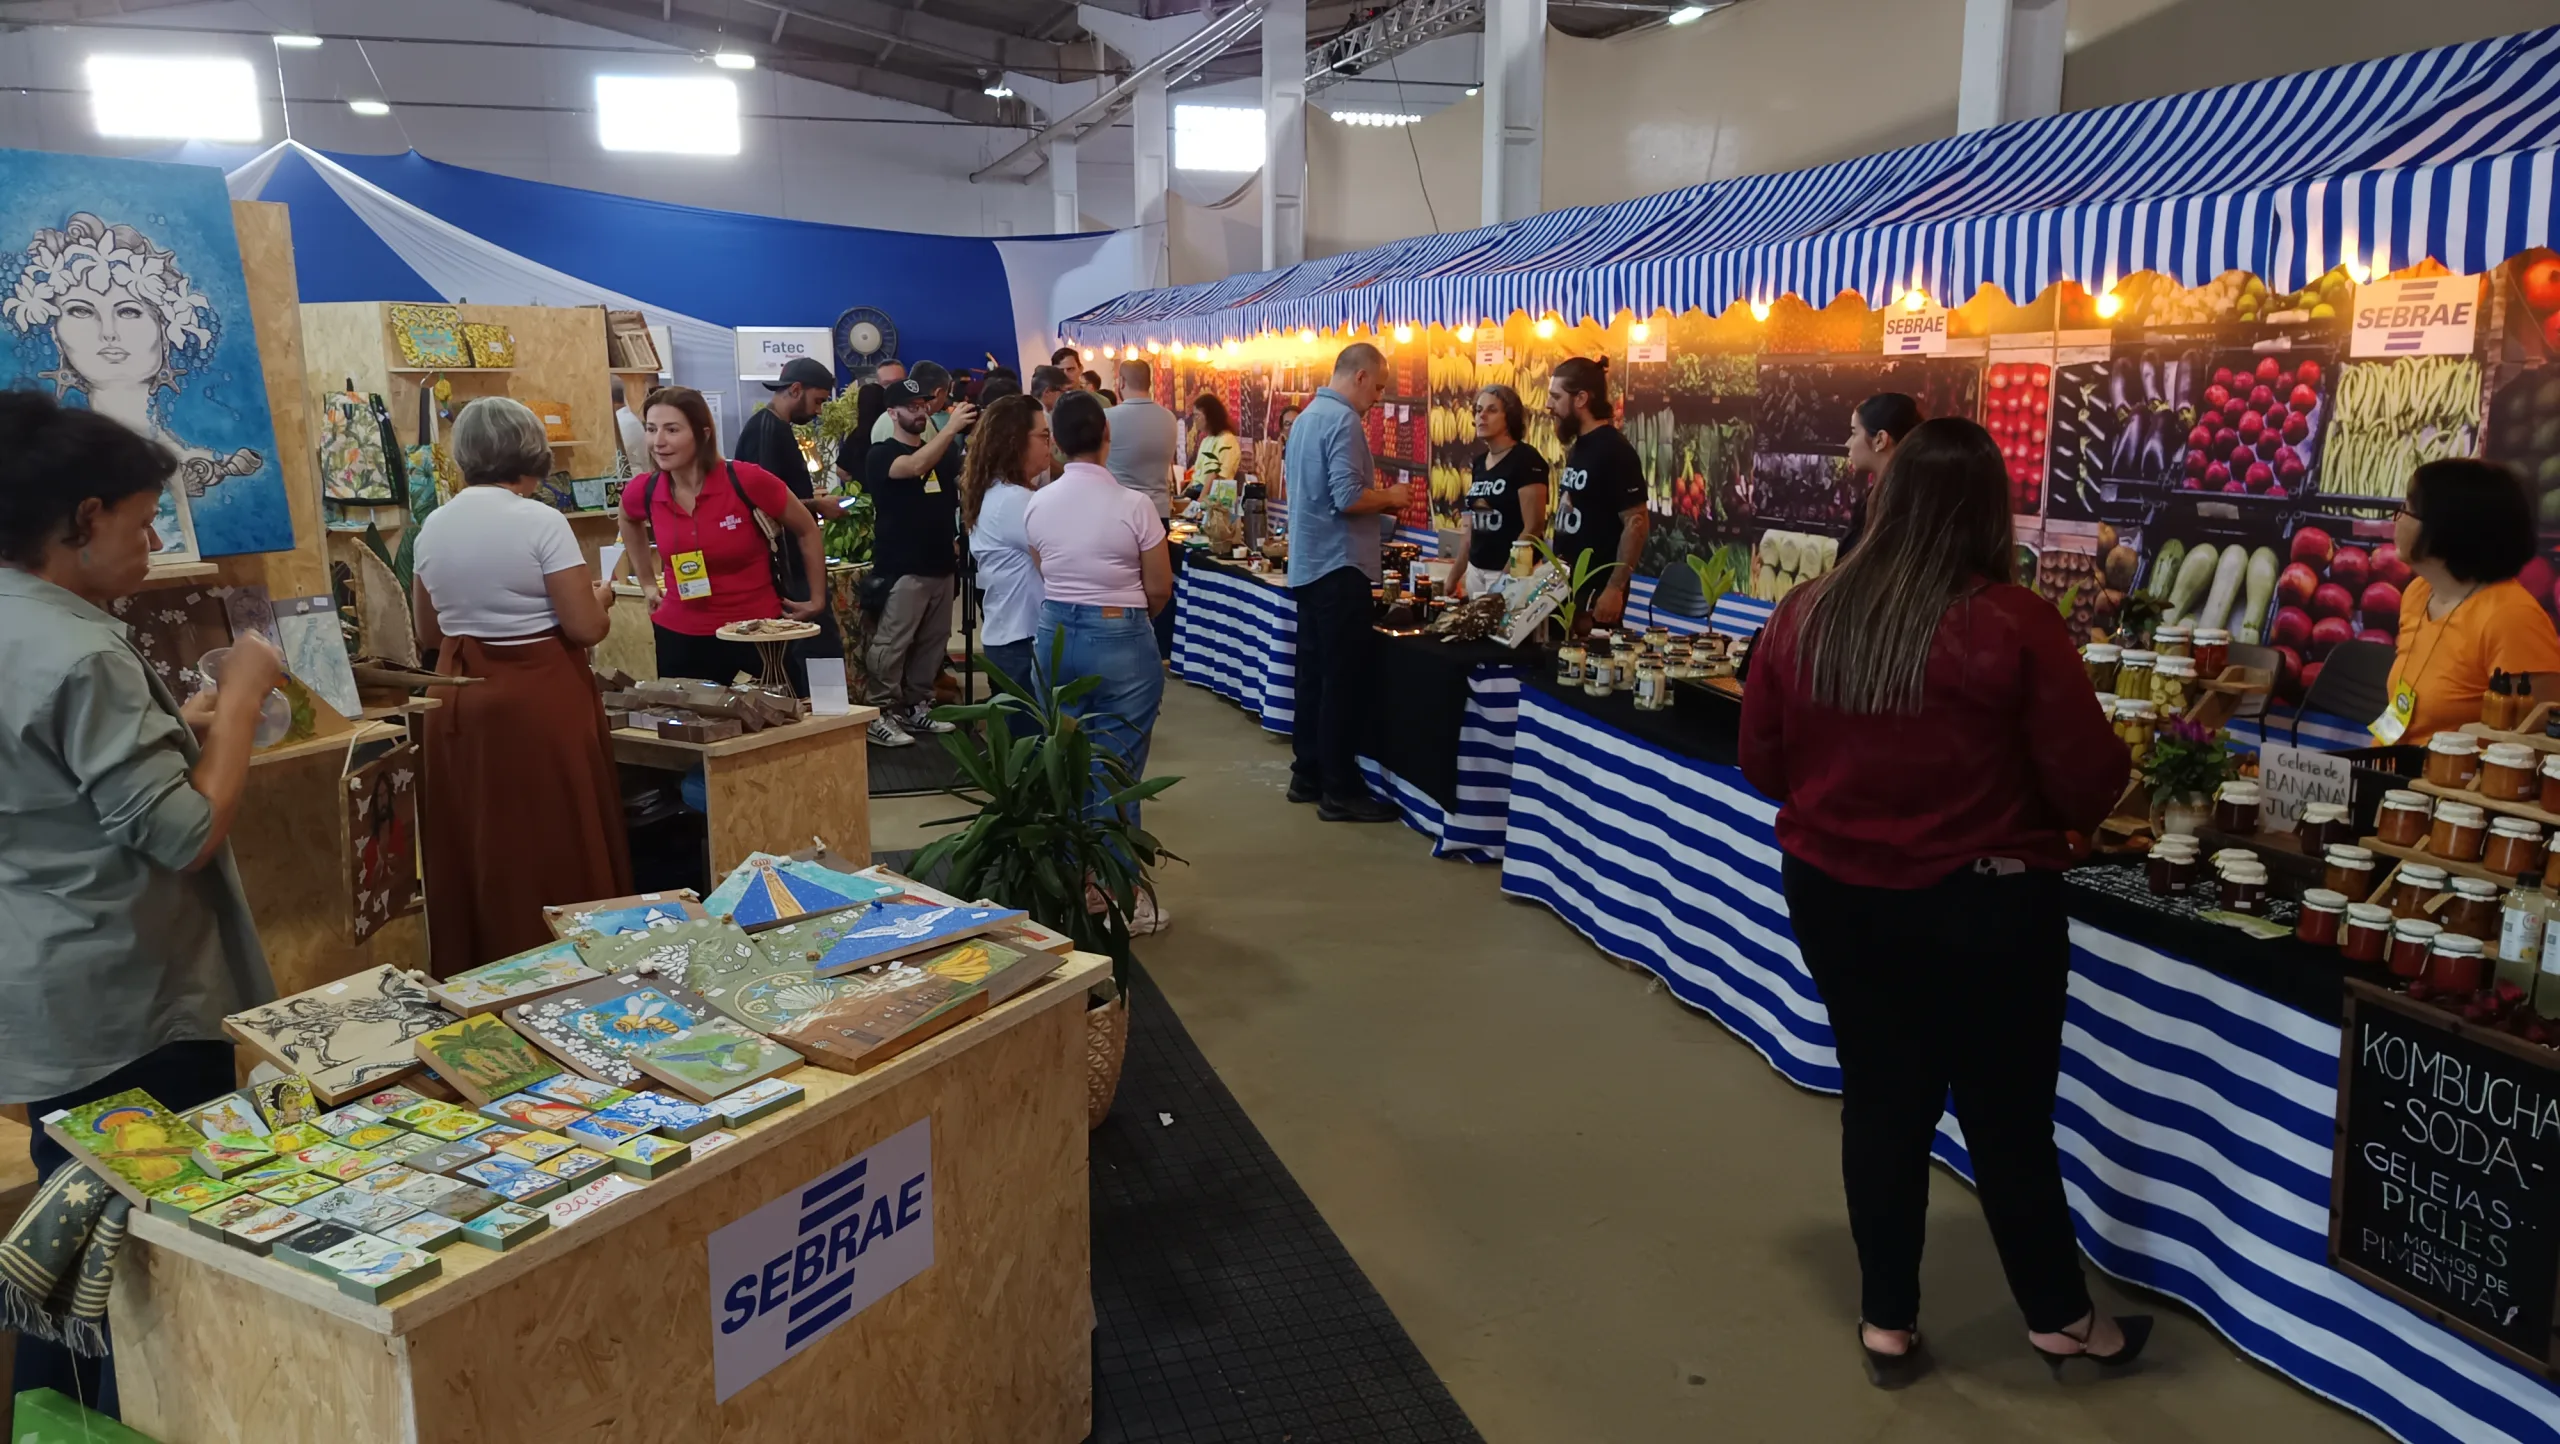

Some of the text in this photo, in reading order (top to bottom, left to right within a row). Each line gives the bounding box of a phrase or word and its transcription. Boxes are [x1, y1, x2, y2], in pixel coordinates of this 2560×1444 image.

[762, 340, 805, 354] Fatec
[1886, 316, 1945, 335] SEBRAE
[2356, 302, 2473, 329] SEBRAE
[2362, 1022, 2560, 1141] KOMBUCHA
[2401, 1098, 2531, 1190] SODA
[555, 1194, 589, 1217] 20
[2381, 1181, 2508, 1267] PICLES
[720, 1171, 926, 1335] SEBRAE
[2403, 1231, 2510, 1297] MOLHOS DE
